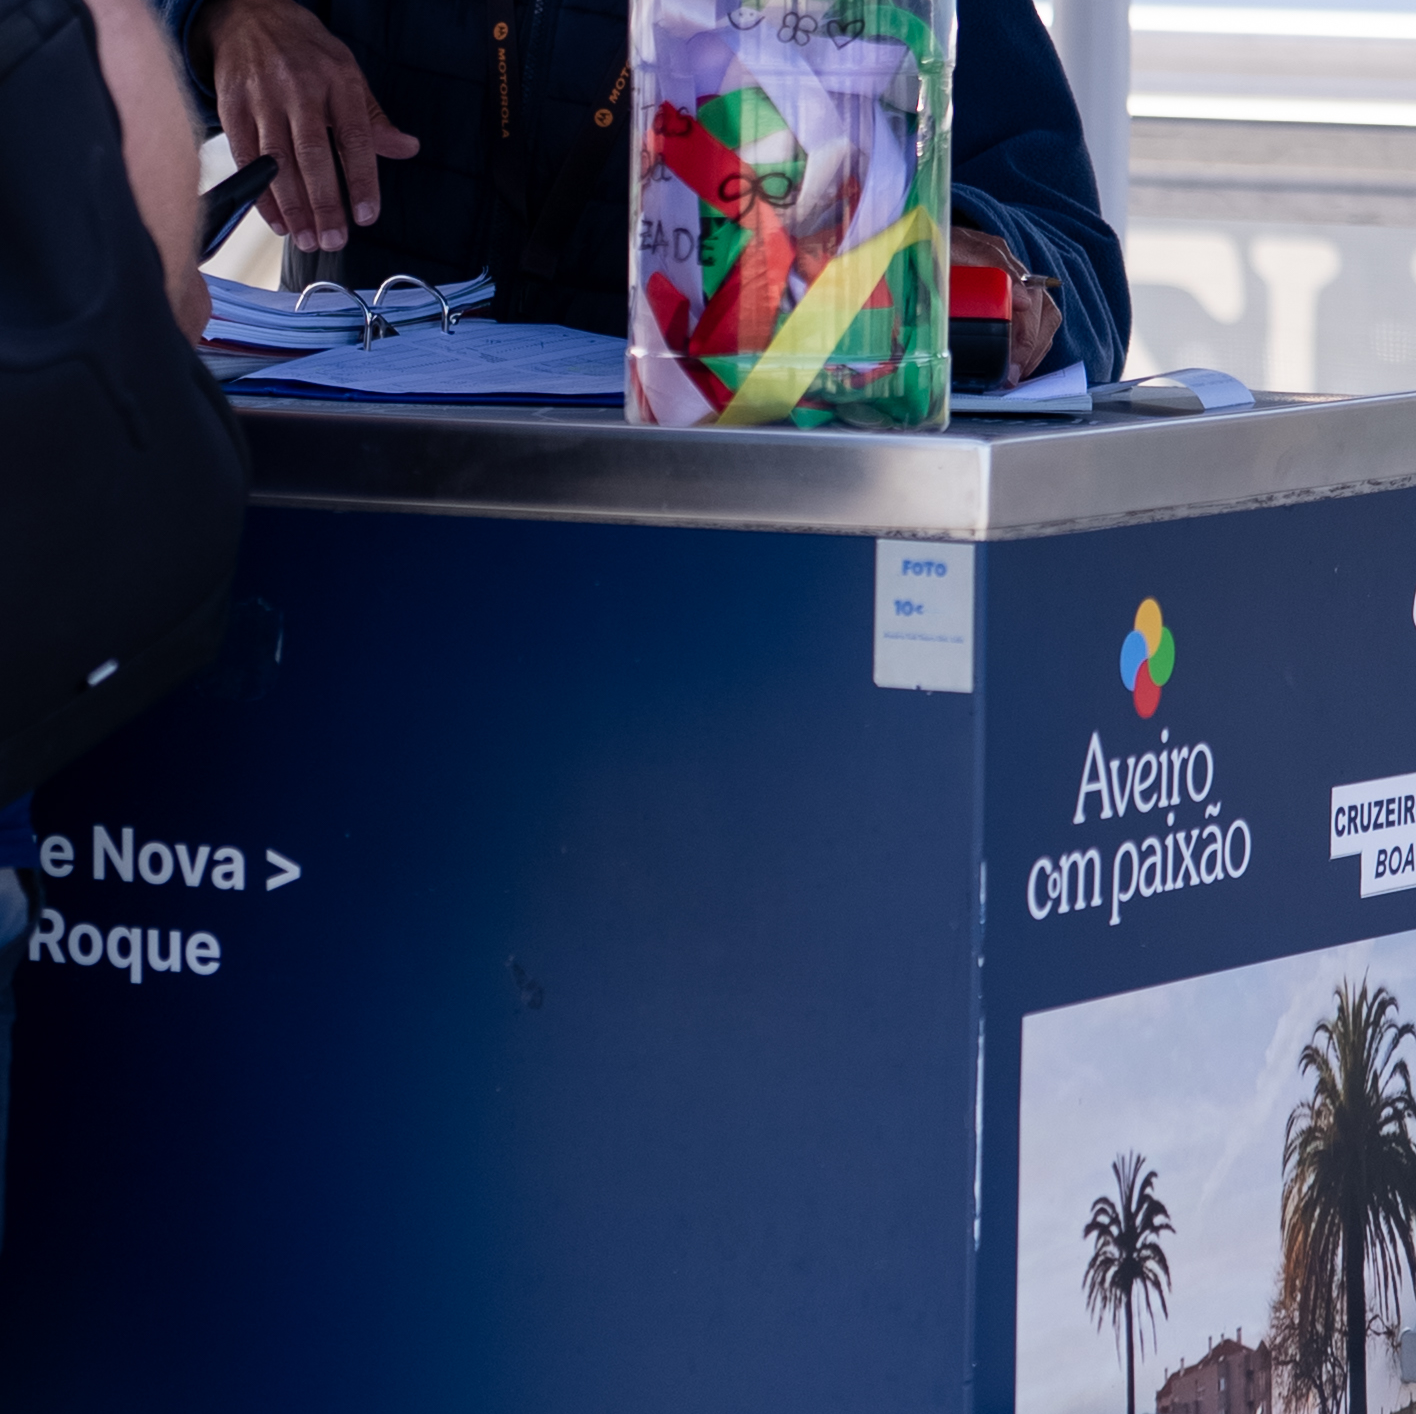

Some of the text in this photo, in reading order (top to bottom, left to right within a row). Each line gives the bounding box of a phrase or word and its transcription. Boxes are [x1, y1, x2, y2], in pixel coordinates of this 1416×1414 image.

[497, 47, 510, 138] MOTOROLA
[902, 560, 947, 578] FOTO
[1073, 727, 1214, 825] Aveiro
[93, 825, 245, 891] Nova
[1109, 800, 1252, 926] paixão
[29, 908, 221, 984] Roque
